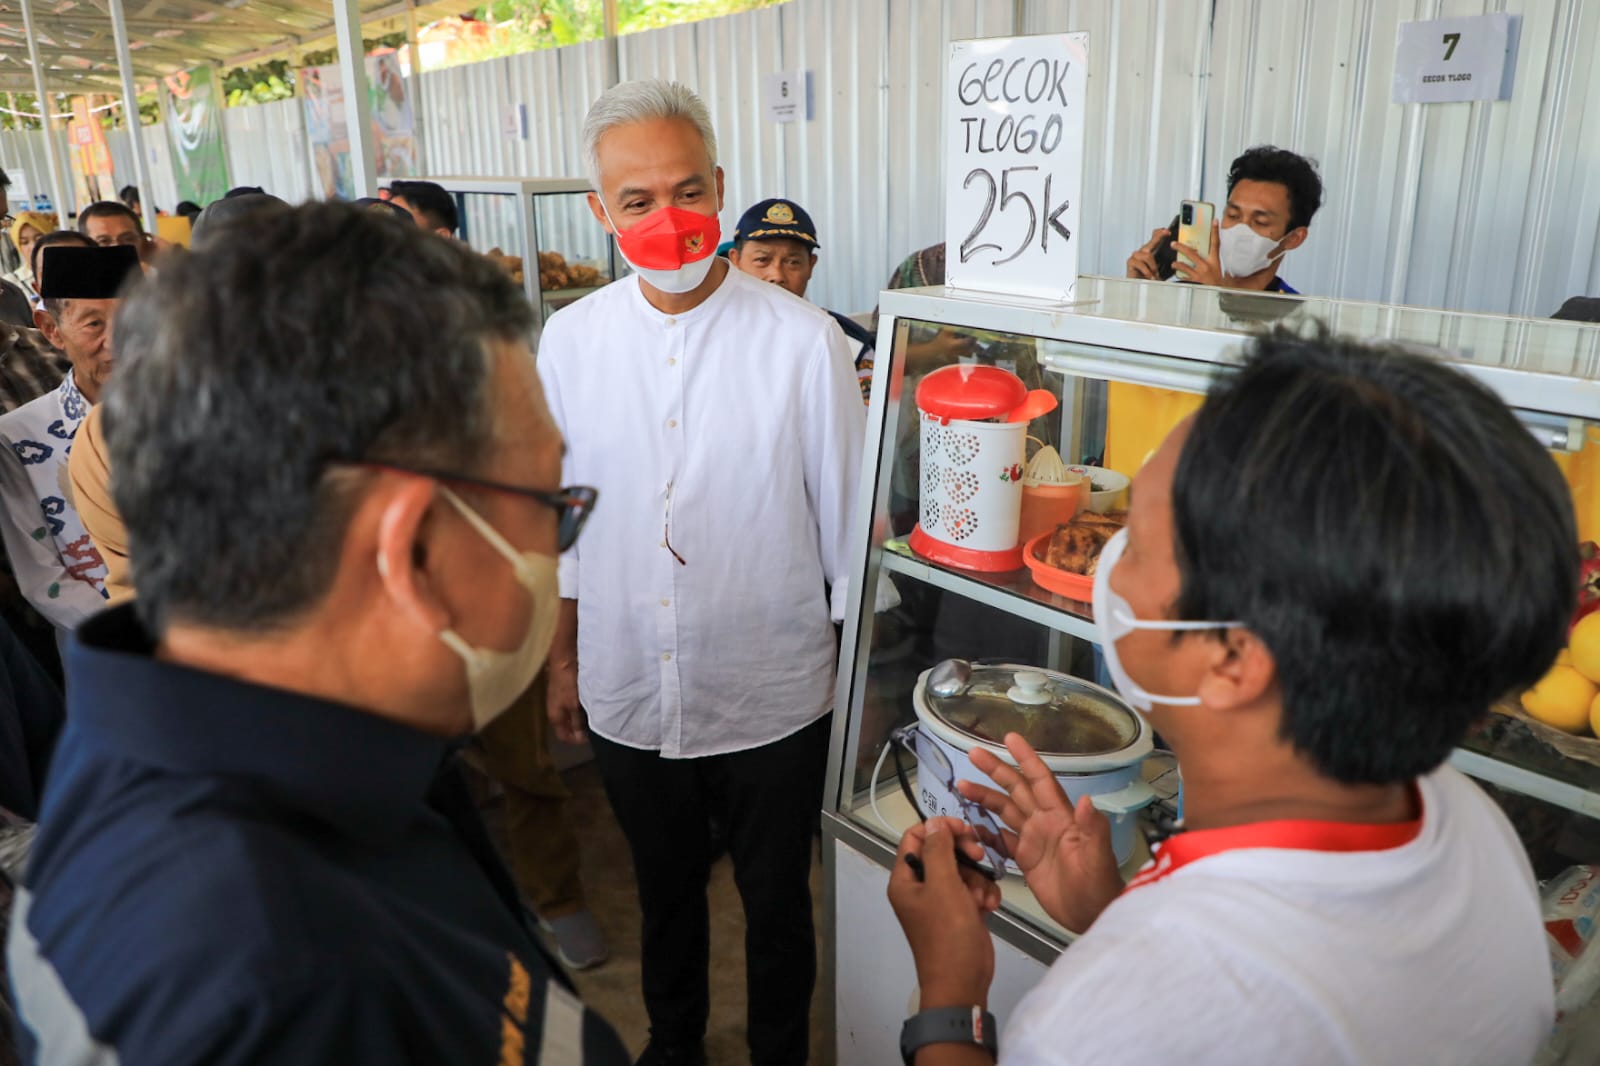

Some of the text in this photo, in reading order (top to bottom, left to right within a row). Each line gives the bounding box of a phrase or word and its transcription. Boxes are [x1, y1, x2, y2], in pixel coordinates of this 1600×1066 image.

[1442, 32, 1461, 61] 7
[781, 80, 789, 98] 6
[960, 113, 1063, 155] TLOGO
